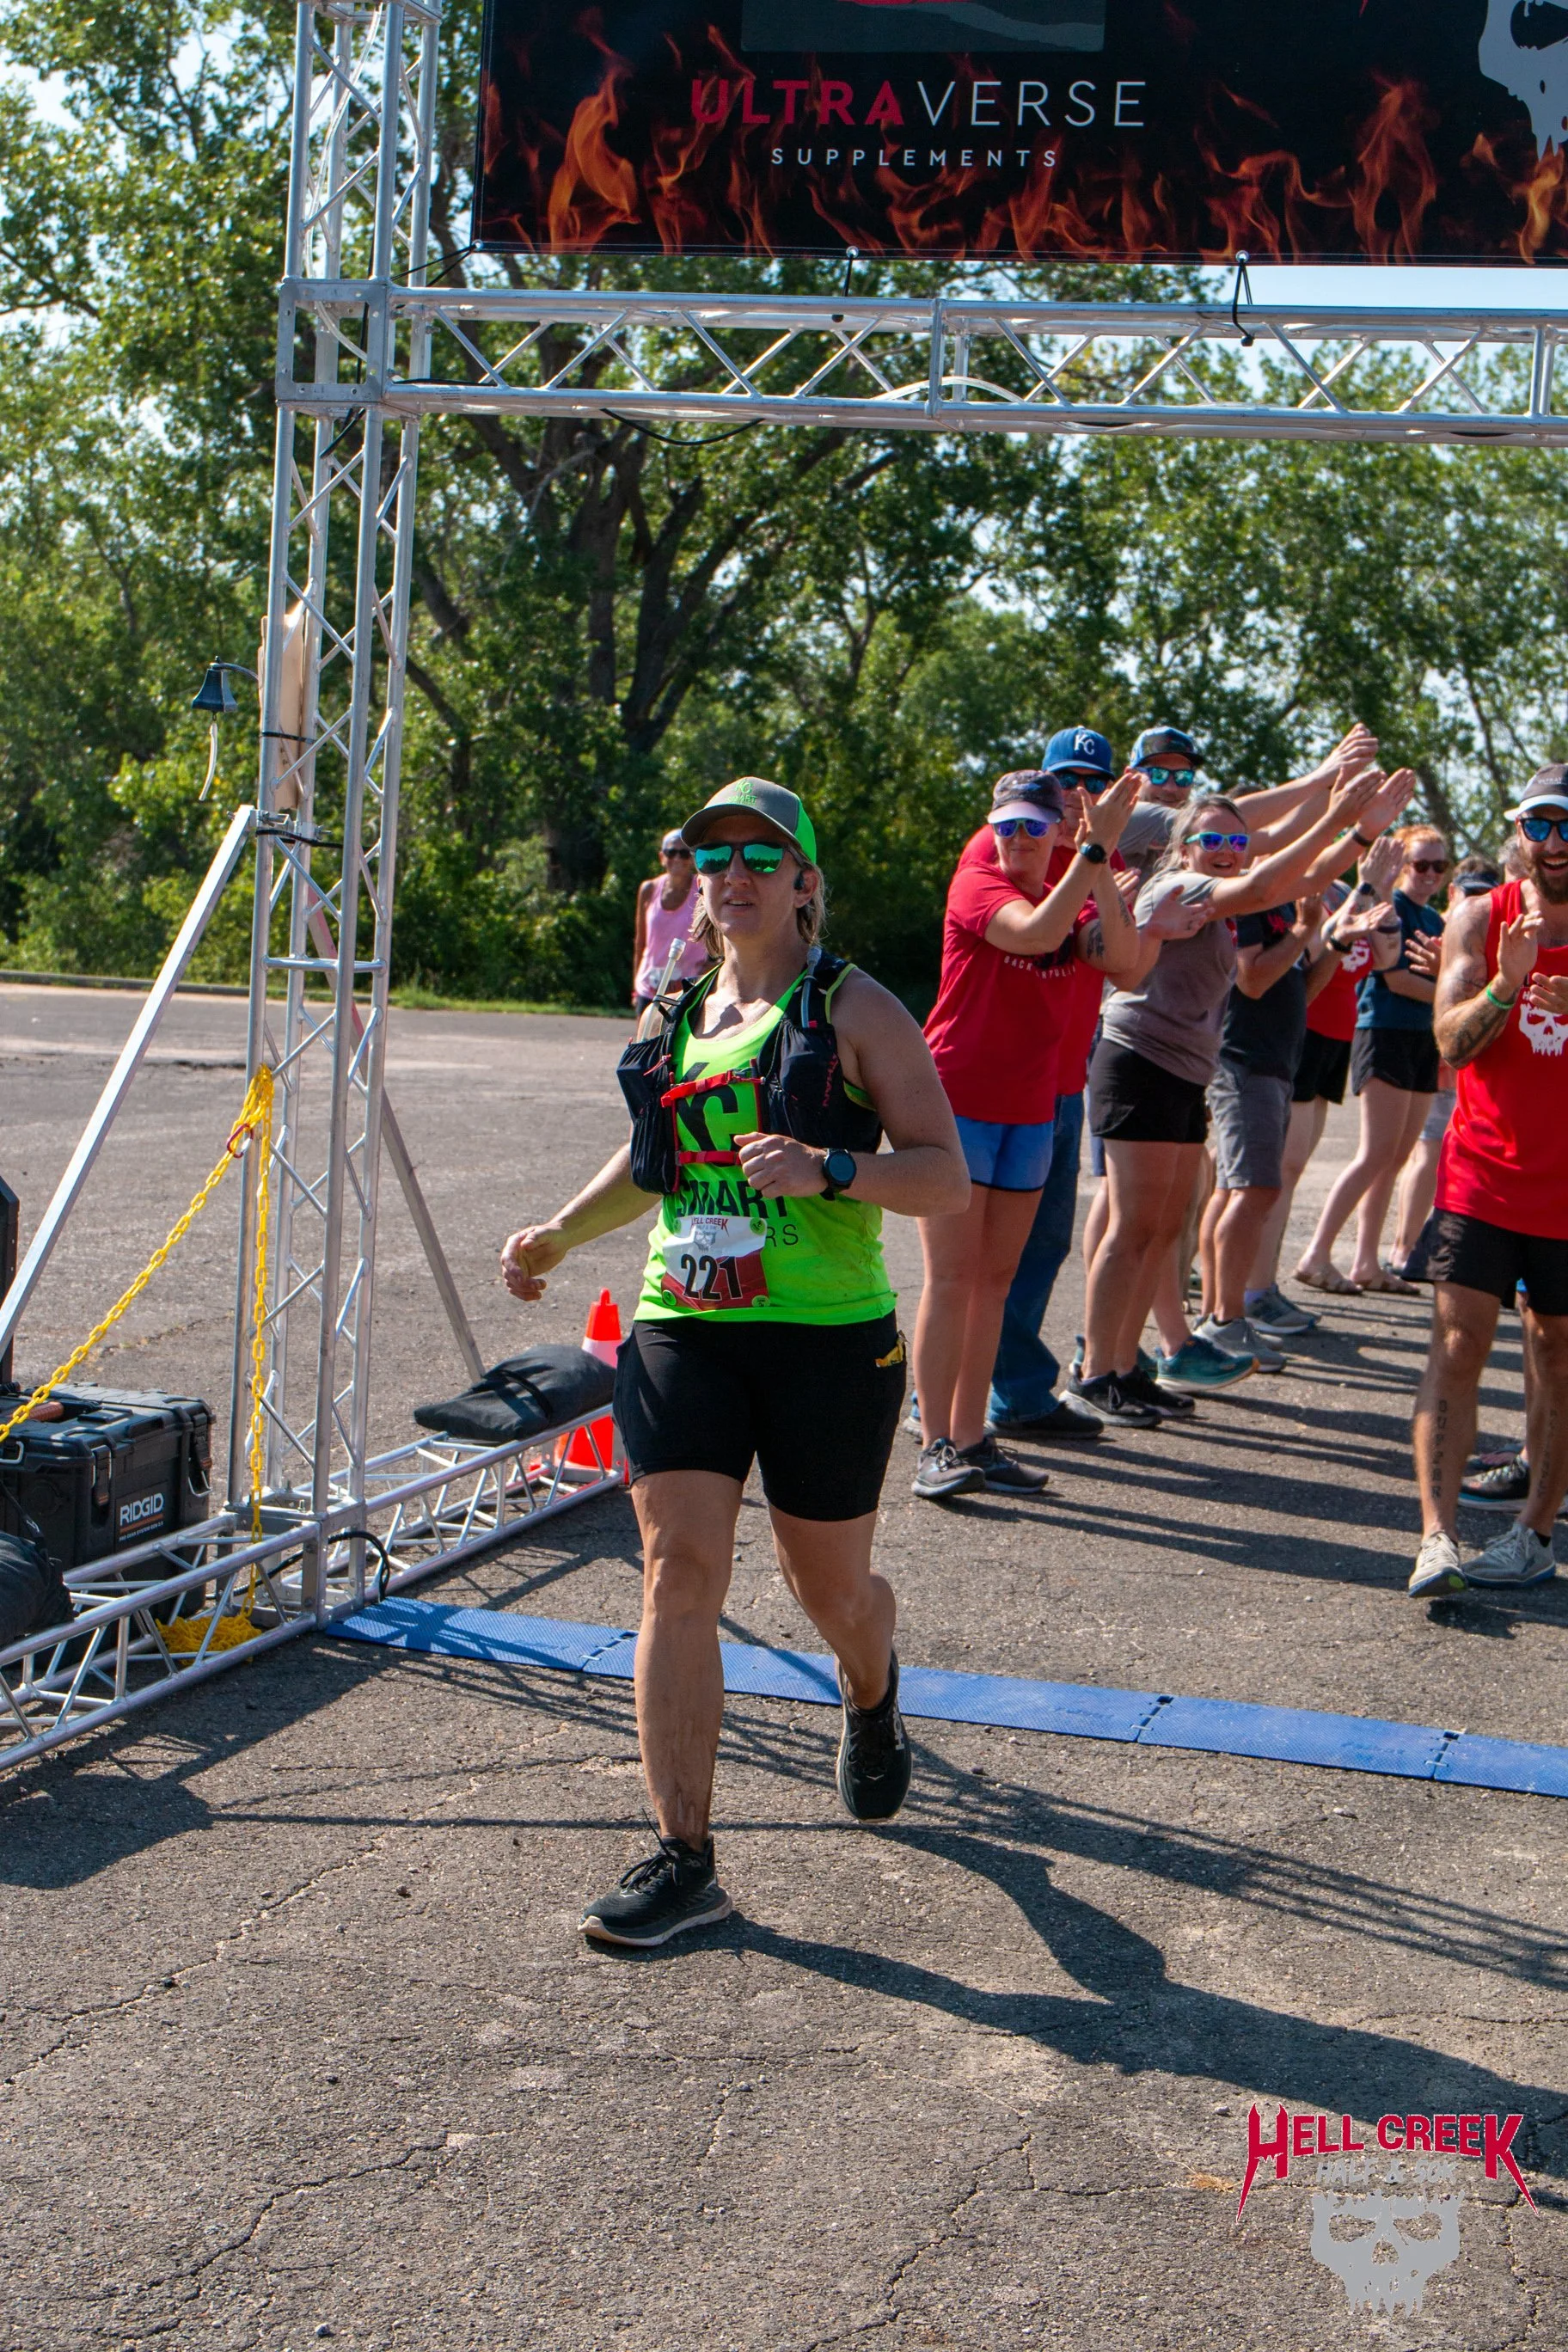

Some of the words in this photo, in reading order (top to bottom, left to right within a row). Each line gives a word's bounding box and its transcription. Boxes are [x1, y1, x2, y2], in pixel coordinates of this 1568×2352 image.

[690, 79, 1147, 127] ULTRAVERSE
[770, 147, 1057, 168] SUPPLEMENTS
[1074, 734, 1095, 756] KC
[705, 1217, 730, 1238] CREEK
[680, 1253, 743, 1302] 221
[119, 1492, 165, 1527] RIDGID
